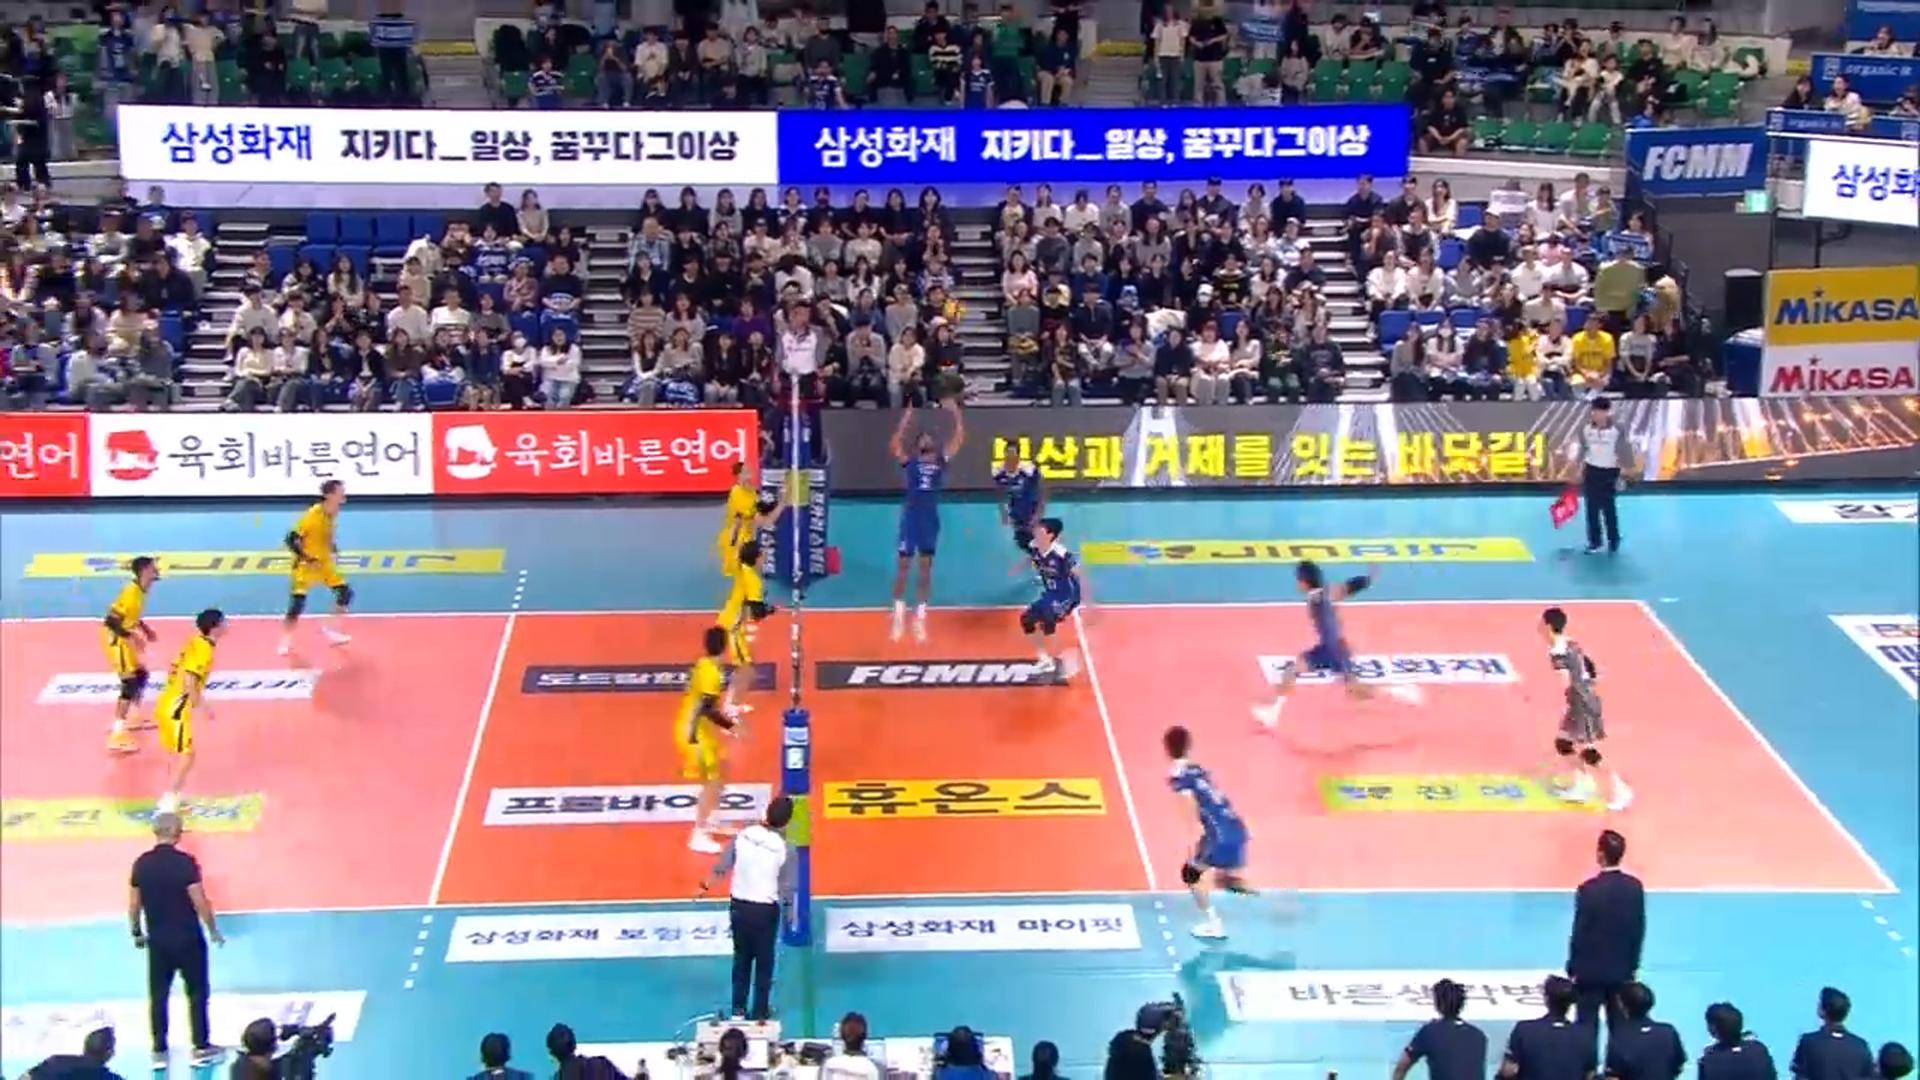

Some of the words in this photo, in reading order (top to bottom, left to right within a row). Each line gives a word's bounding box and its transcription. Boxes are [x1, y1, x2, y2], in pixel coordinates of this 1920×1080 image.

[161, 123, 312, 164] 삼성화재
[340, 127, 541, 166] 지키다_일상,
[550, 129, 739, 162] 꿈꾸다그이상
[815, 124, 956, 167] 삼성화재
[981, 126, 1174, 163] 지키다_일상,
[1183, 124, 1370, 160] 꿈꾸다그이상
[1643, 143, 1753, 181] FCMM
[0, 431, 79, 480] 연어
[168, 431, 422, 482] 육회바른연어
[505, 430, 748, 482] 육회바른연어
[1145, 431, 1273, 478] 거제를
[1294, 432, 1376, 477] 잇는
[1400, 430, 1545, 476] 바닷길!
[537, 670, 725, 687] 도드람한
[848, 663, 1032, 684] FCMM
[828, 781, 1102, 814] 휴온스
[466, 927, 599, 945] 삼성화재
[614, 924, 734, 942] 보험선
[841, 918, 996, 938] 삼성화재
[1017, 917, 1123, 933] 마이핏
